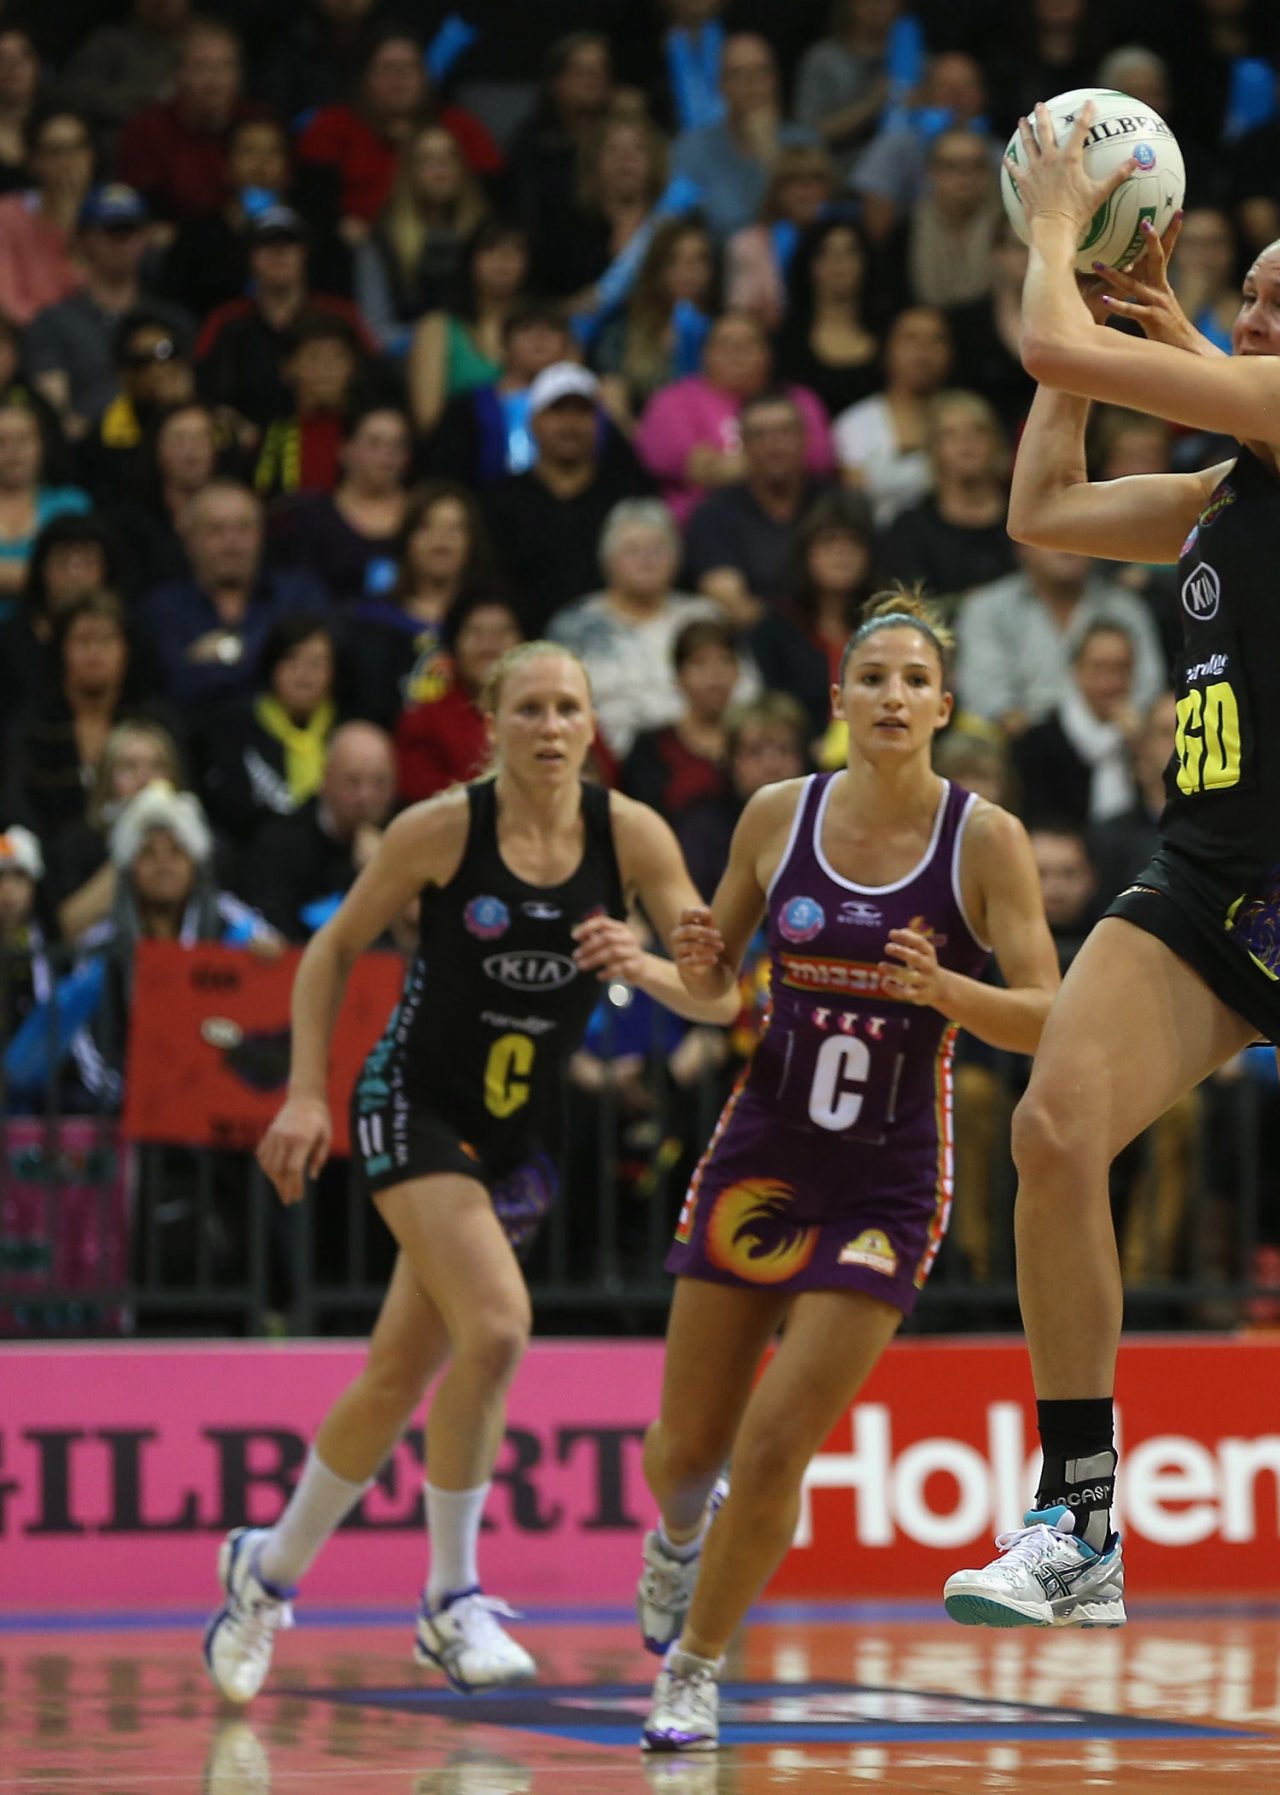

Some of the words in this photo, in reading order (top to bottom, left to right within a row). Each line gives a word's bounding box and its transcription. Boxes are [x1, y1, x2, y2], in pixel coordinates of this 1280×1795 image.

[1190, 573, 1217, 612] KIA
[1176, 681, 1242, 796] GD
[500, 957, 561, 980] KIA
[484, 1033, 535, 1119] C
[808, 1034, 871, 1132] C
[0, 1428, 648, 1533] ILBERT
